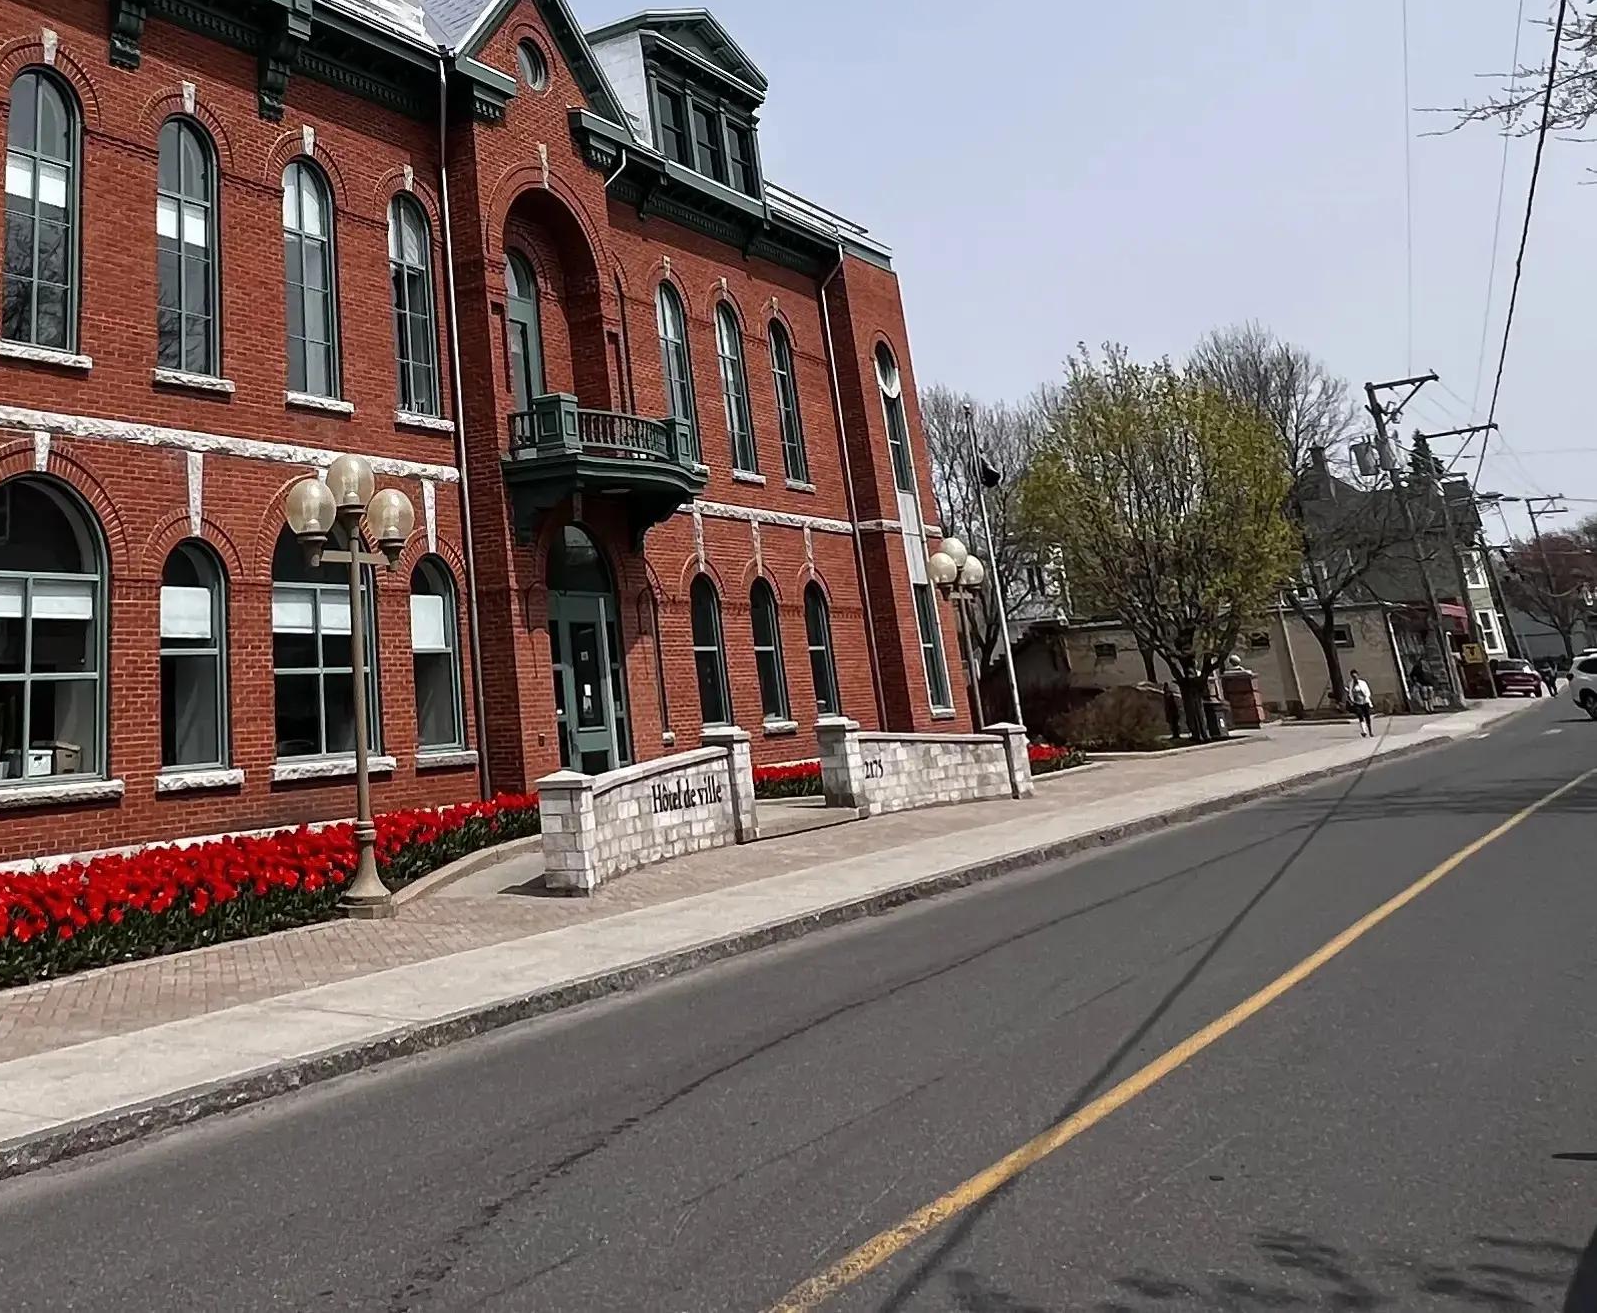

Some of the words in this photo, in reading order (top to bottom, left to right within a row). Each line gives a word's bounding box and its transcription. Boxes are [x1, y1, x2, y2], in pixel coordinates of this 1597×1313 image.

[862, 758, 884, 779] 2175
[651, 779, 683, 814] Hôtel
[684, 778, 697, 808] de
[697, 775, 723, 805] ville
